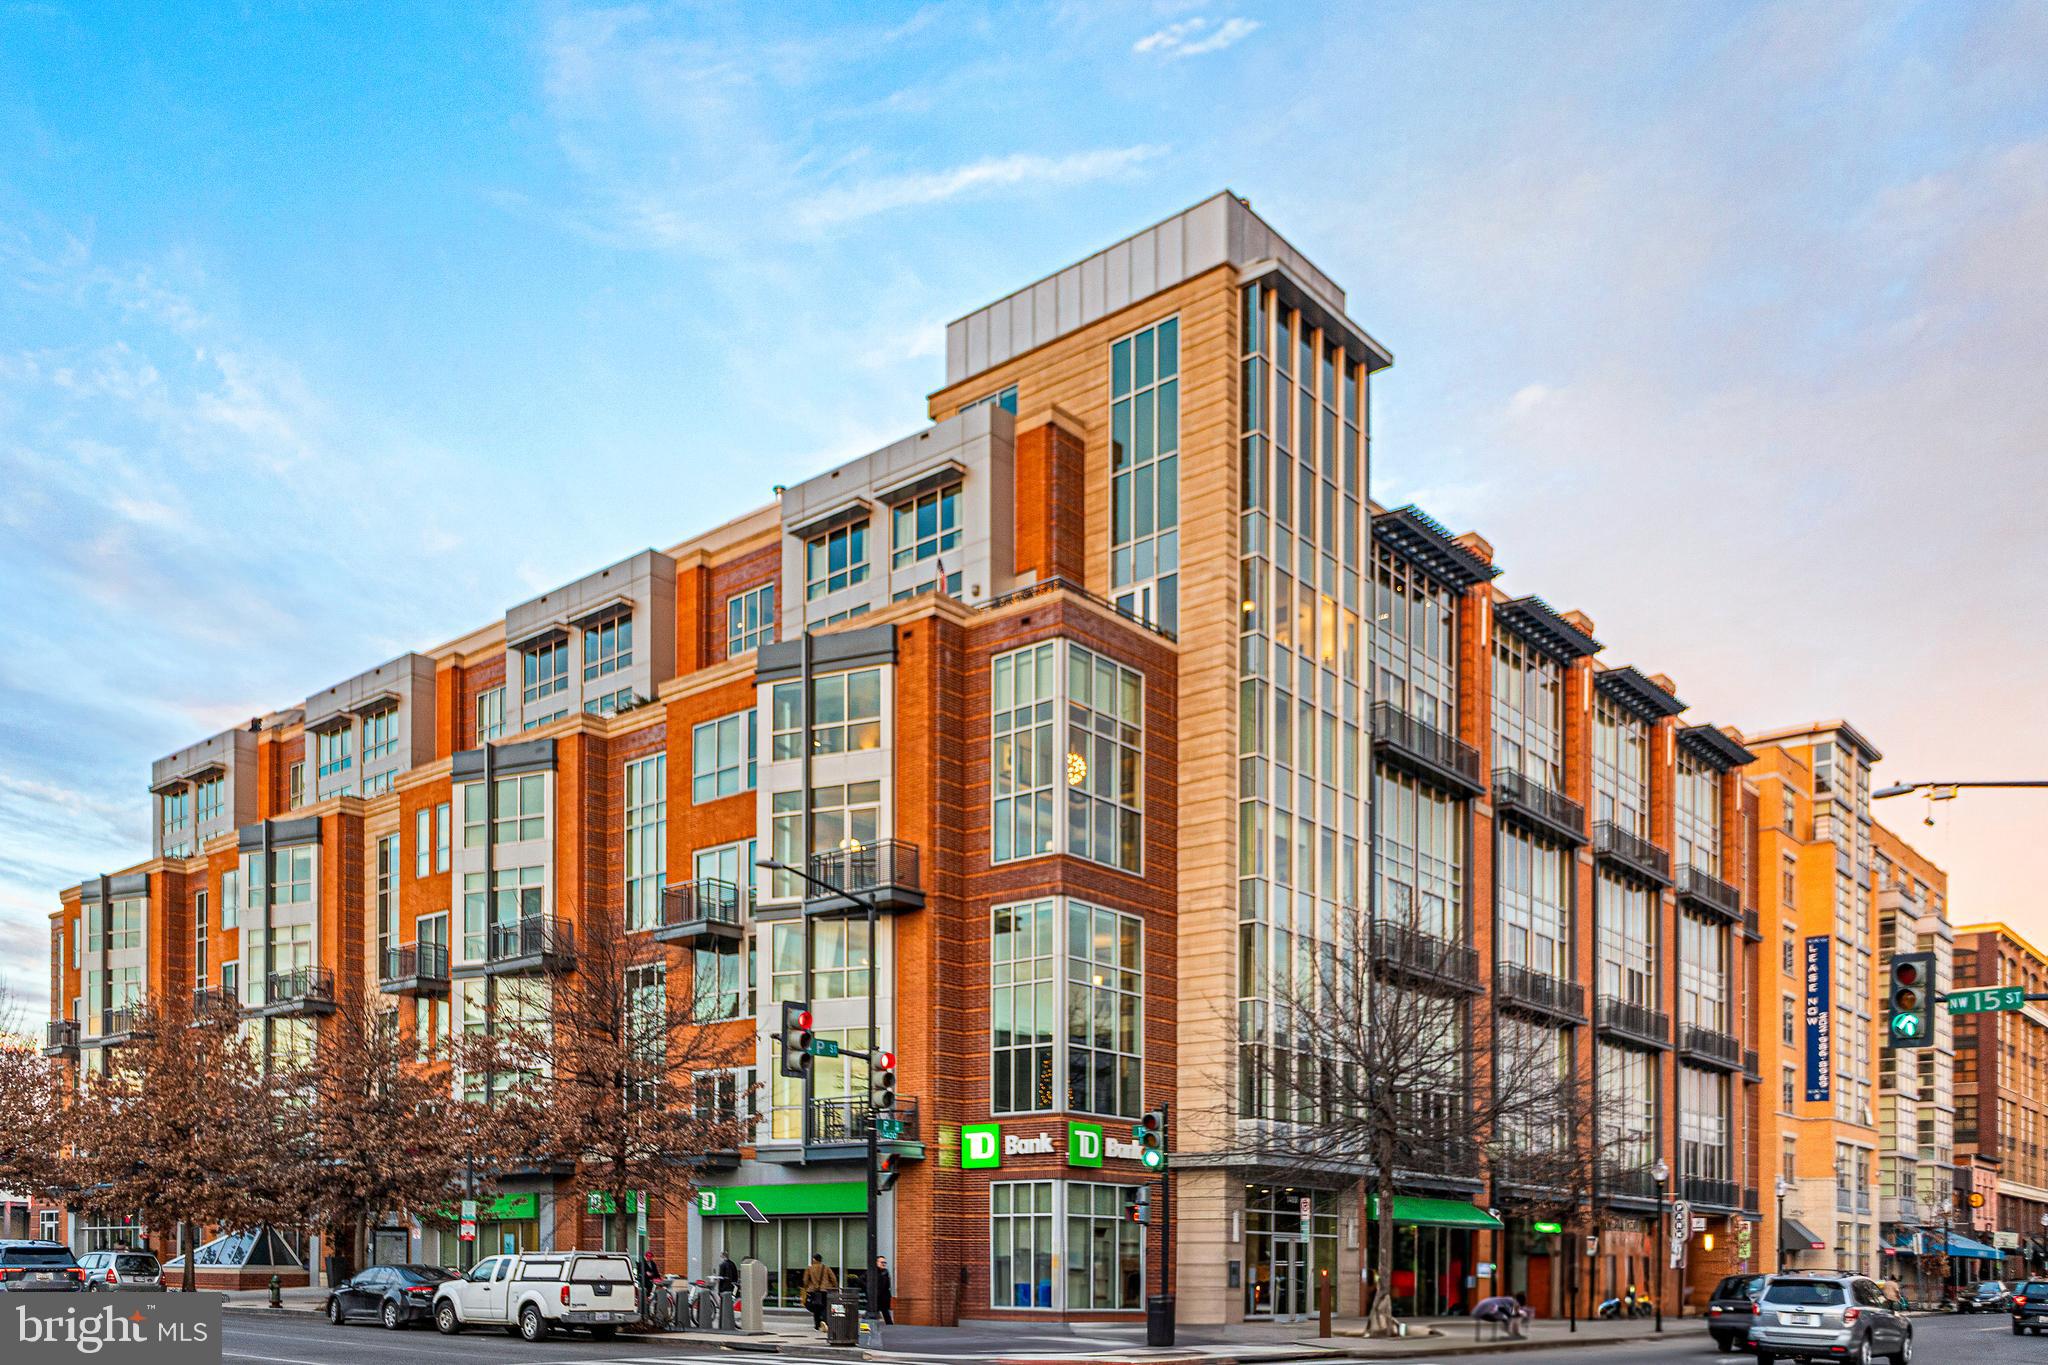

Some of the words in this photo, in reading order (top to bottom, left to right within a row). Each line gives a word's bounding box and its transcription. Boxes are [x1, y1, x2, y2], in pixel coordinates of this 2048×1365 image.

[1808, 944, 1819, 993] LEASE
[1807, 996, 1819, 1026] NOW
[1949, 997, 1969, 1009] NW
[1972, 990, 2001, 1011] 15
[2005, 991, 2022, 1004] ST
[816, 1040, 825, 1055] P
[965, 1132, 995, 1159] TD
[1004, 1132, 1055, 1155] Bank
[1074, 1130, 1099, 1159] TD
